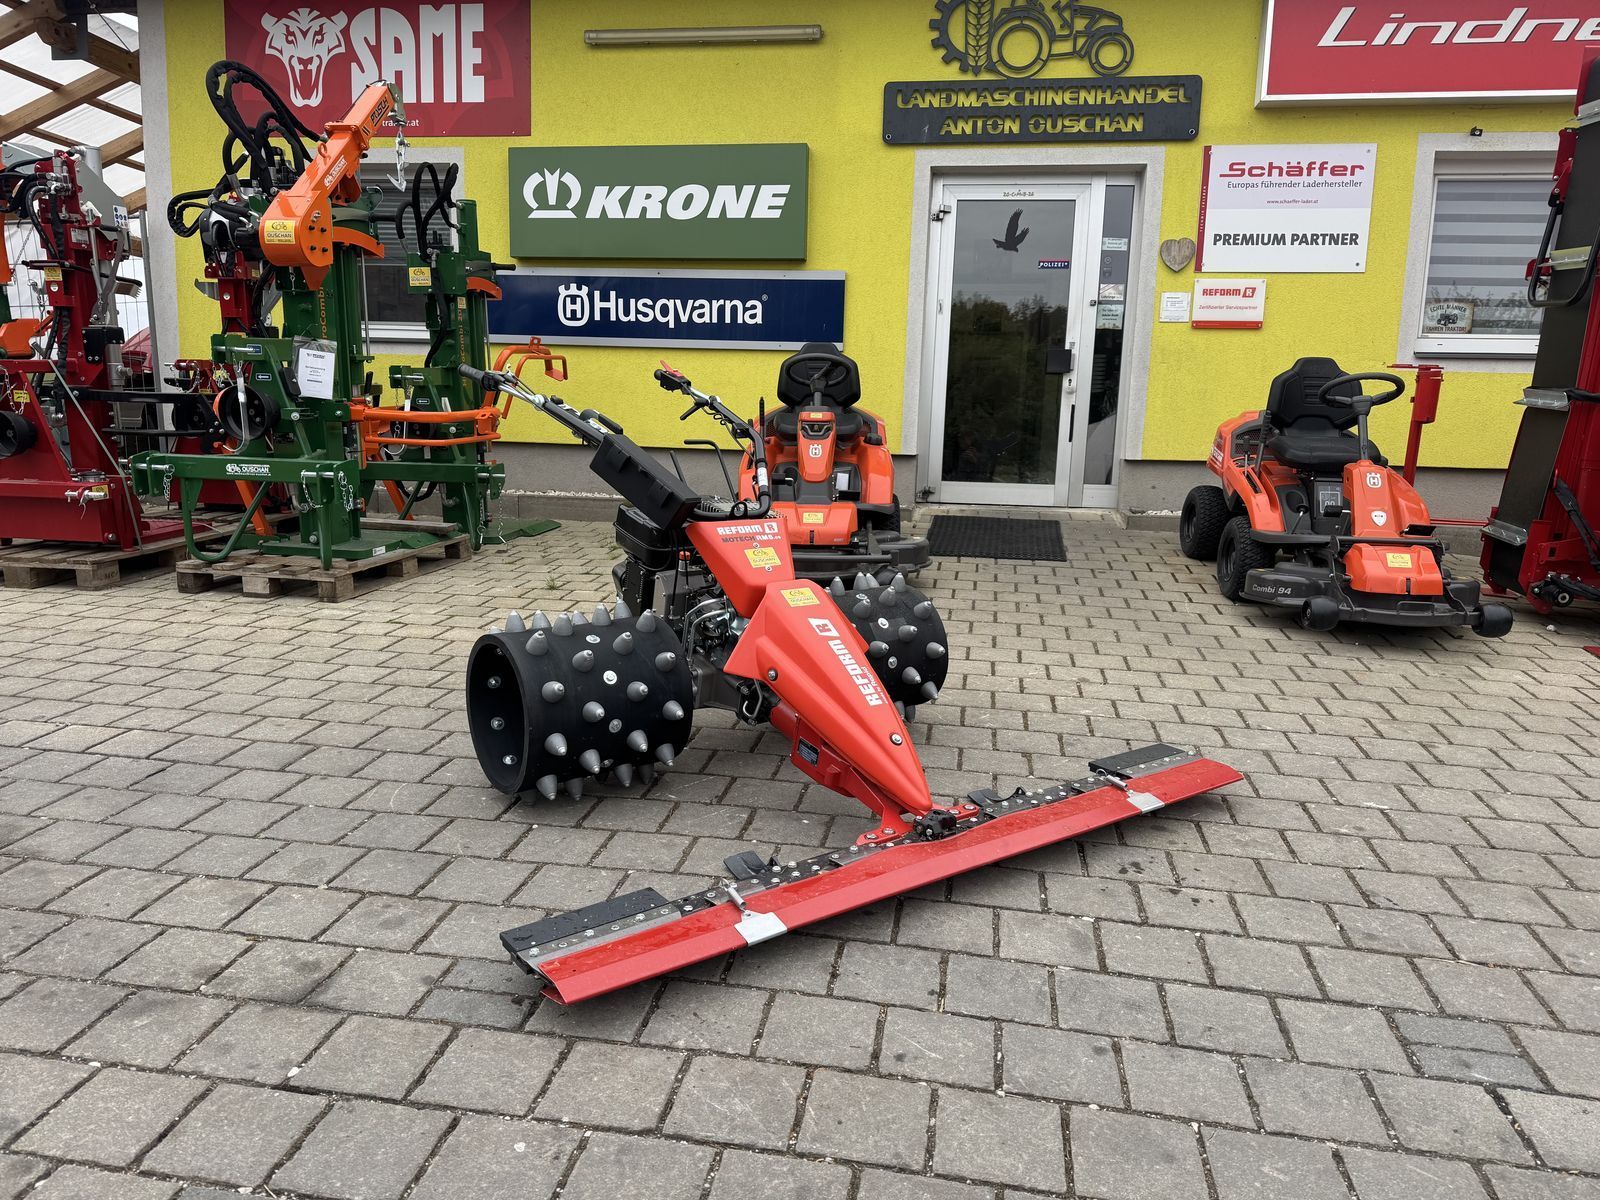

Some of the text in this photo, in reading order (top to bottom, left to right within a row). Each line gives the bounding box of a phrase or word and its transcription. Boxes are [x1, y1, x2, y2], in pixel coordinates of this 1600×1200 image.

[350, 3, 485, 103] SAME
[897, 85, 1190, 108] LANDMASCHINENHANDEL
[939, 112, 1145, 135] ANTON OUSCHAN
[1219, 161, 1365, 178] Schäffer
[1227, 180, 1362, 190] Europas führender Laderhersteller
[585, 184, 791, 220] KRONE
[1213, 233, 1359, 246] PREMIUM PARTNER
[1202, 288, 1241, 296] REFORM
[594, 290, 763, 328] Husqvarna
[717, 525, 763, 535] REFORM
[1253, 584, 1292, 595] Combi 94
[828, 639, 883, 706] REFORM
